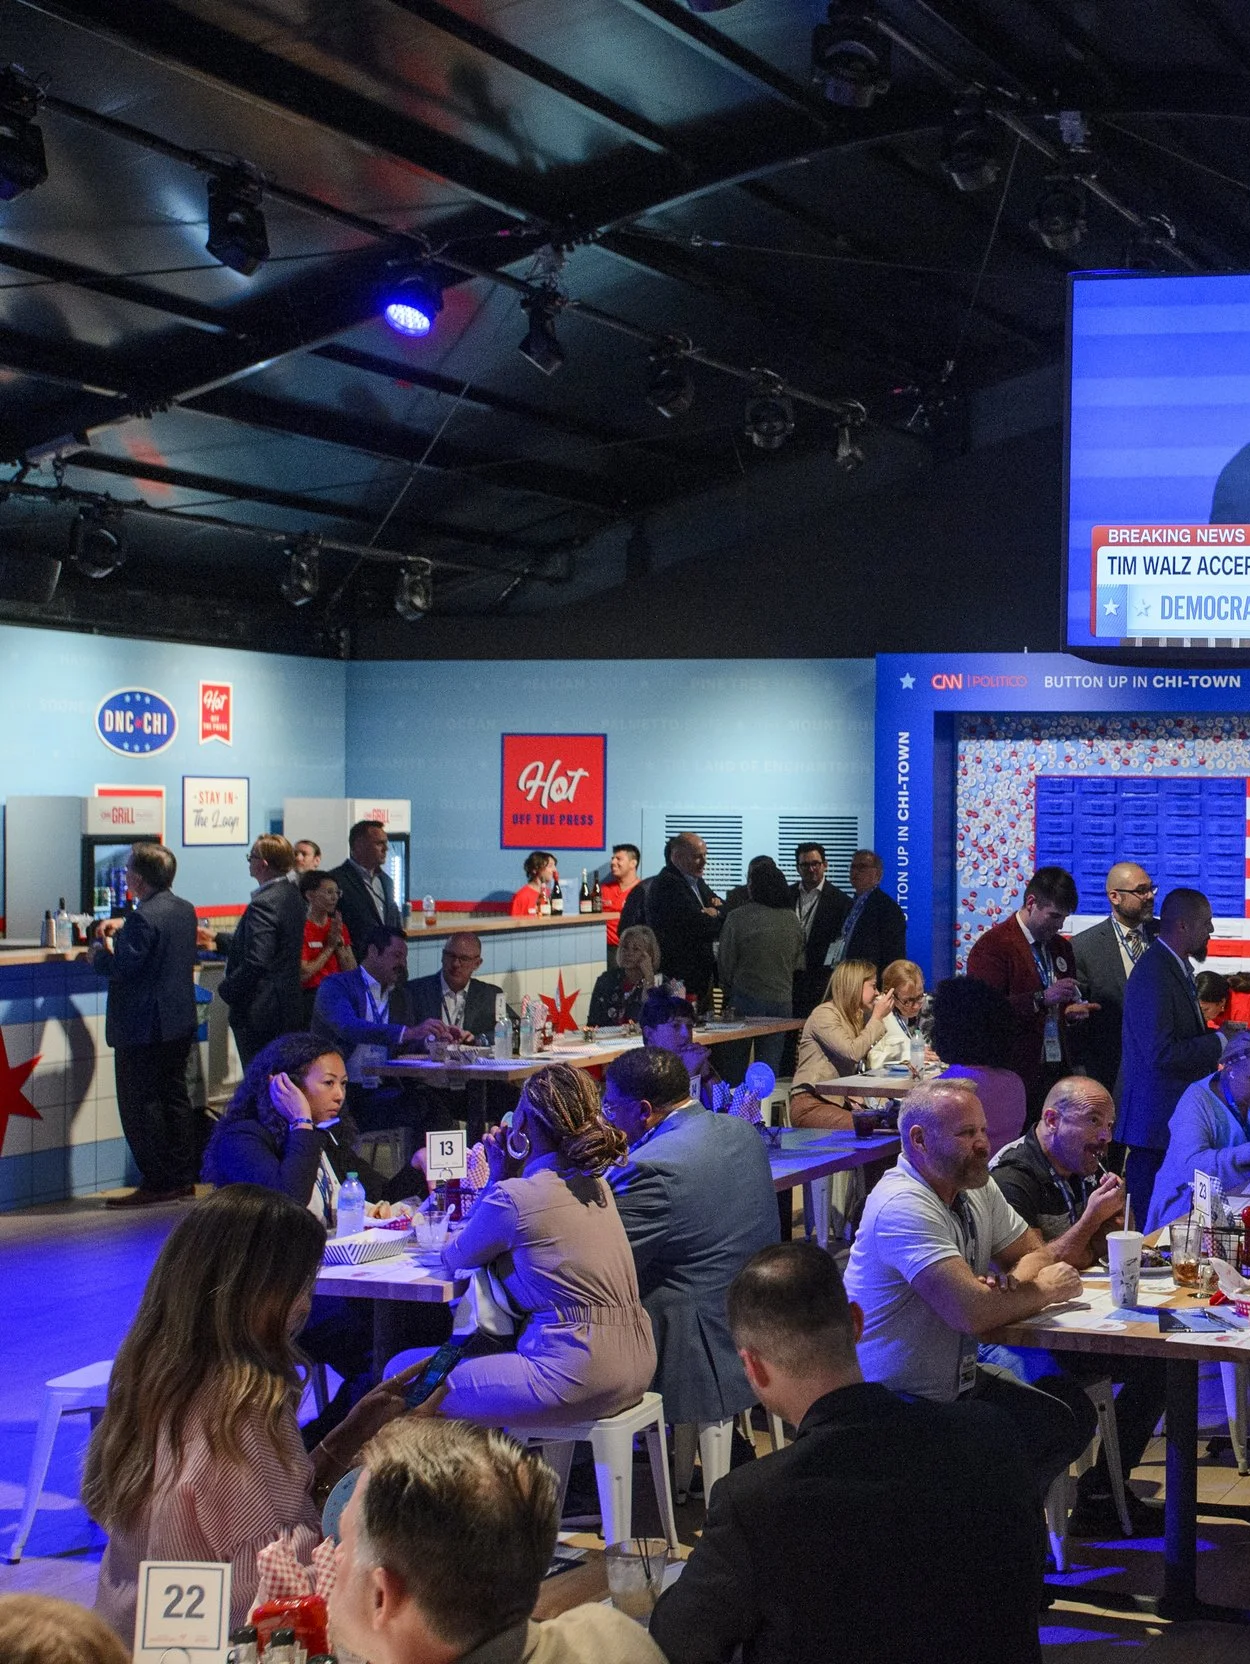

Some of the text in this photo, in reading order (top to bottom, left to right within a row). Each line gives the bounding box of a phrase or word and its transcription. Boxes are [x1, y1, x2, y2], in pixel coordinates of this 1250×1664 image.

[1108, 528, 1246, 543] BREAKING NEWS
[1108, 556, 1137, 575] TIM
[1143, 556, 1192, 575] WALZ
[931, 673, 1242, 690] CNN POLITICO BUTTON UP IN CHI-TOWN
[104, 709, 168, 735] DNC CHI
[518, 758, 590, 810] Hot
[897, 731, 910, 821] CHI-TOWN
[199, 791, 234, 806] STAY IN
[193, 808, 208, 829] The
[512, 813, 594, 826] OFF THE PRESS
[897, 826, 909, 842] IN
[897, 846, 909, 867] UP
[439, 1140, 454, 1156] 13
[1199, 1182, 1207, 1200] 23
[162, 1583, 206, 1619] 22
